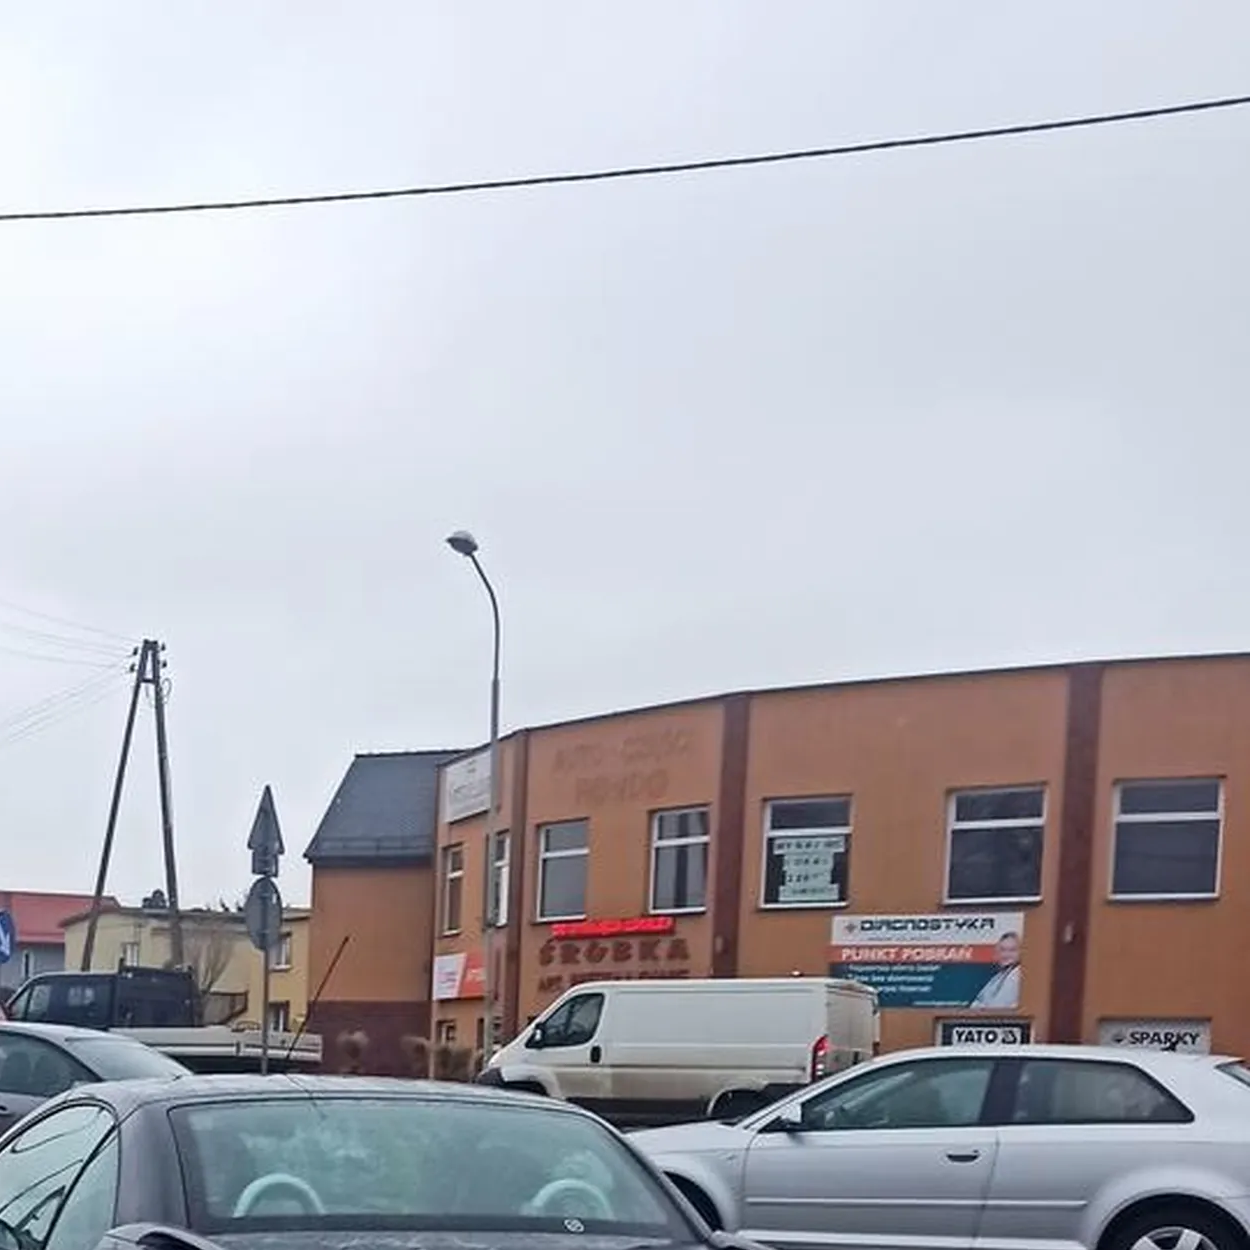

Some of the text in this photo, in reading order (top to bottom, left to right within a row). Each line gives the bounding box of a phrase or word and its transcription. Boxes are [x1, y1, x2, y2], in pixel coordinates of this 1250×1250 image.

[860, 918, 995, 932] DIAGNOSTYKA
[954, 1029, 998, 1045] YATO
[1130, 1031, 1200, 1045] SPARKY
